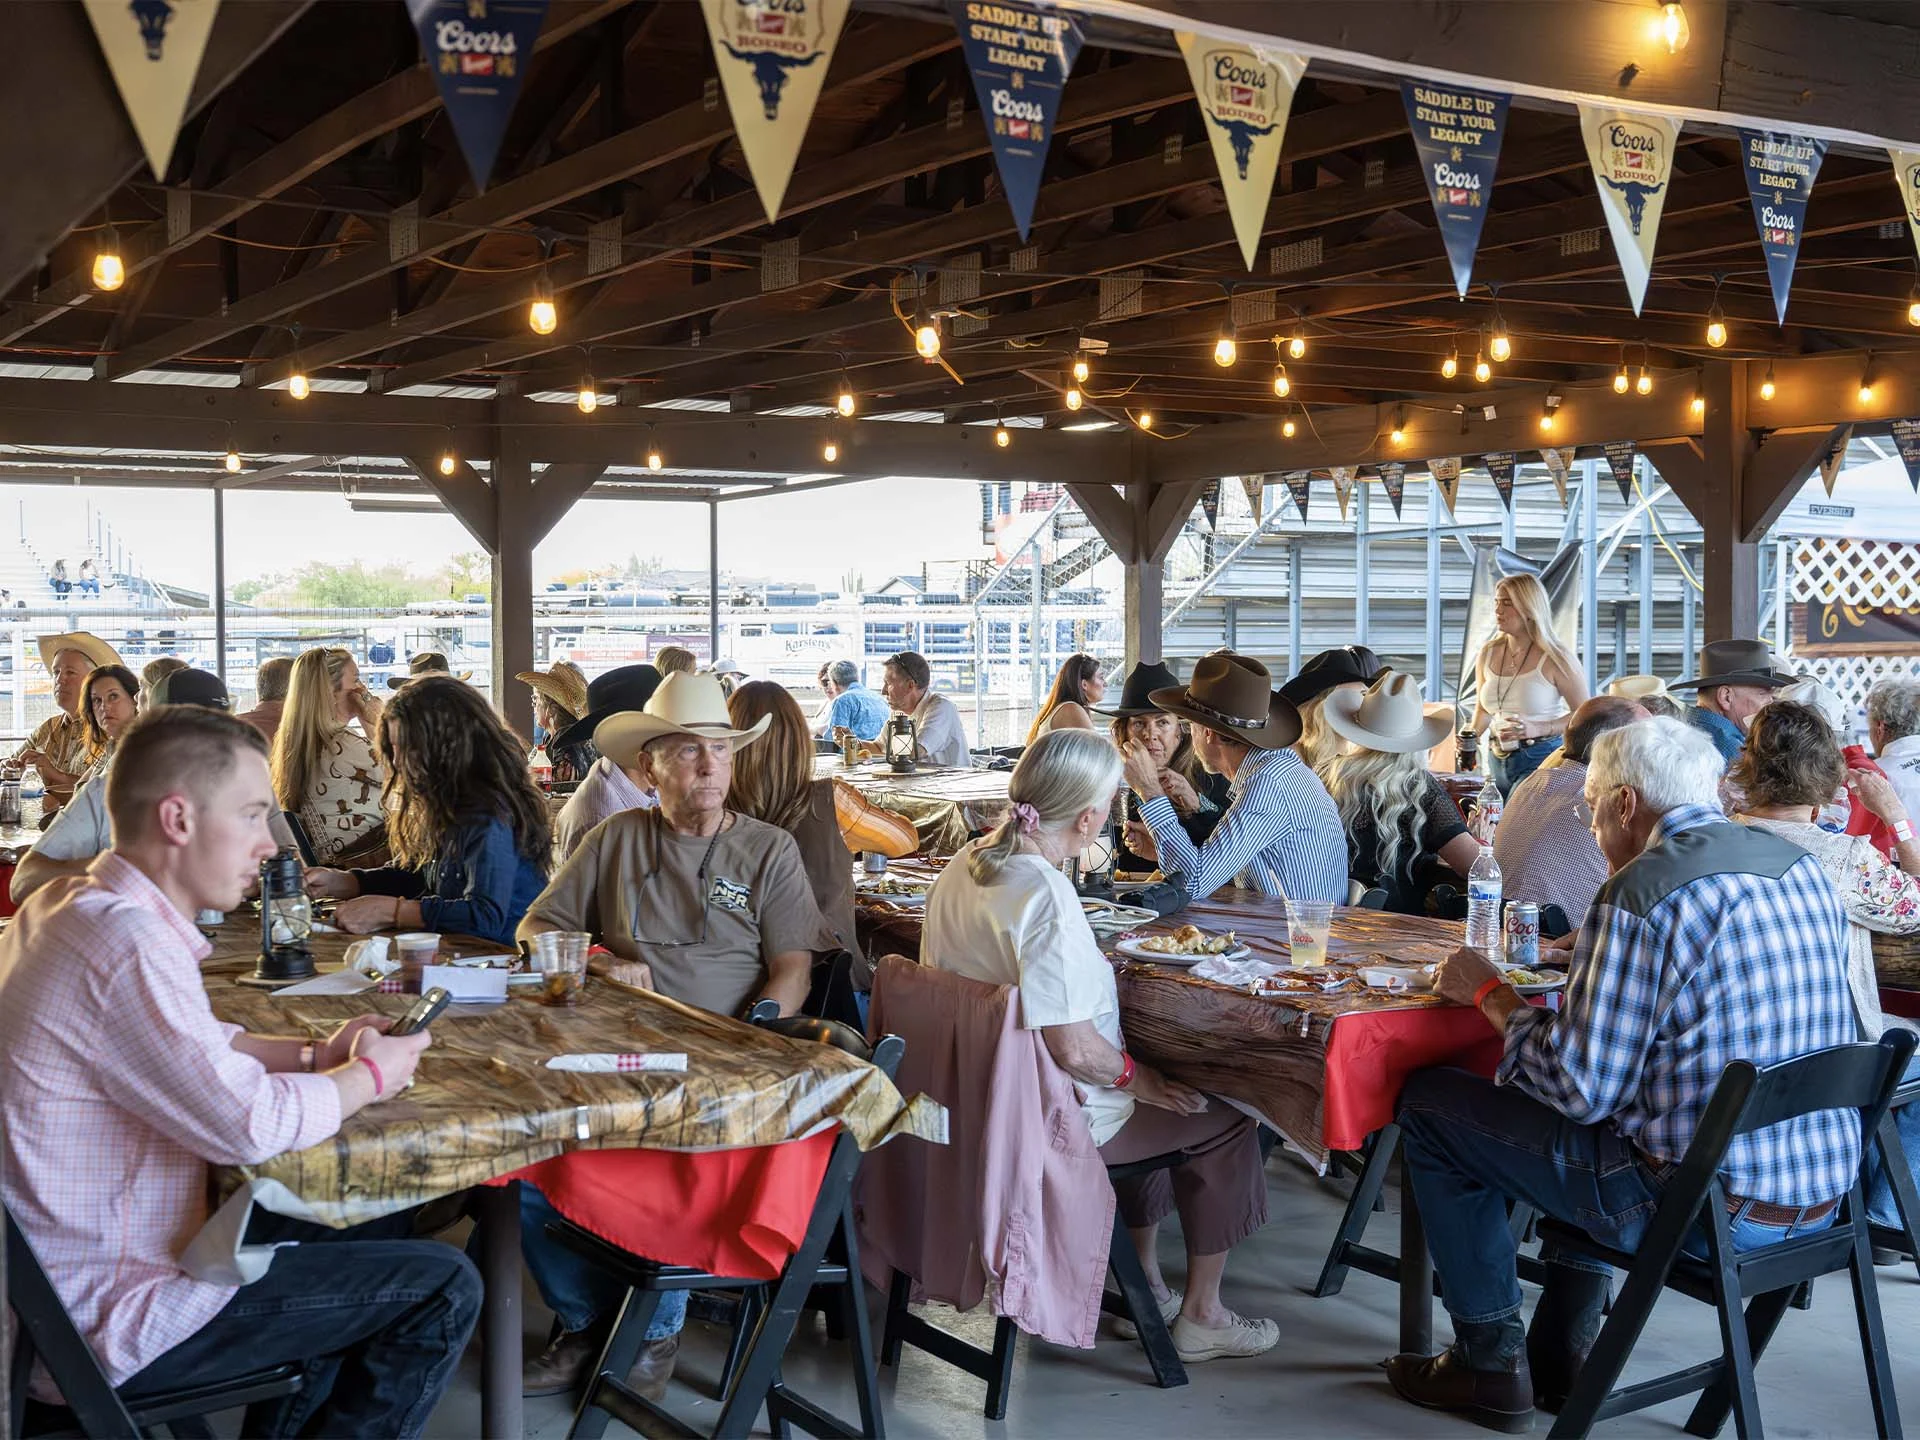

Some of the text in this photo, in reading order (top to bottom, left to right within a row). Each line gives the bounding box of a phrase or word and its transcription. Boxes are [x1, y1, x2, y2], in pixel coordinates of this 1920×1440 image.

[967, 3, 1071, 36] SADDLE UP
[435, 19, 517, 55] Coors
[970, 23, 1063, 56] START YOUR
[988, 47, 1046, 72] LEGACY
[1214, 56, 1267, 88] Coors
[991, 89, 1045, 122] Coors
[1414, 87, 1496, 114] SADDLE UP
[1216, 105, 1266, 124] RODEO
[1416, 106, 1496, 131] START YOUR
[1429, 126, 1482, 145] LEGACY
[1609, 125, 1655, 152] Coors
[1750, 138, 1815, 160] SADDLE UP
[1434, 163, 1482, 189] Coors
[1614, 169, 1656, 184] RODEO
[1750, 156, 1810, 176] START YOUR
[1760, 173, 1798, 189] LEGACY
[1761, 206, 1796, 230] Coors
[1508, 935, 1537, 945] LIGH
